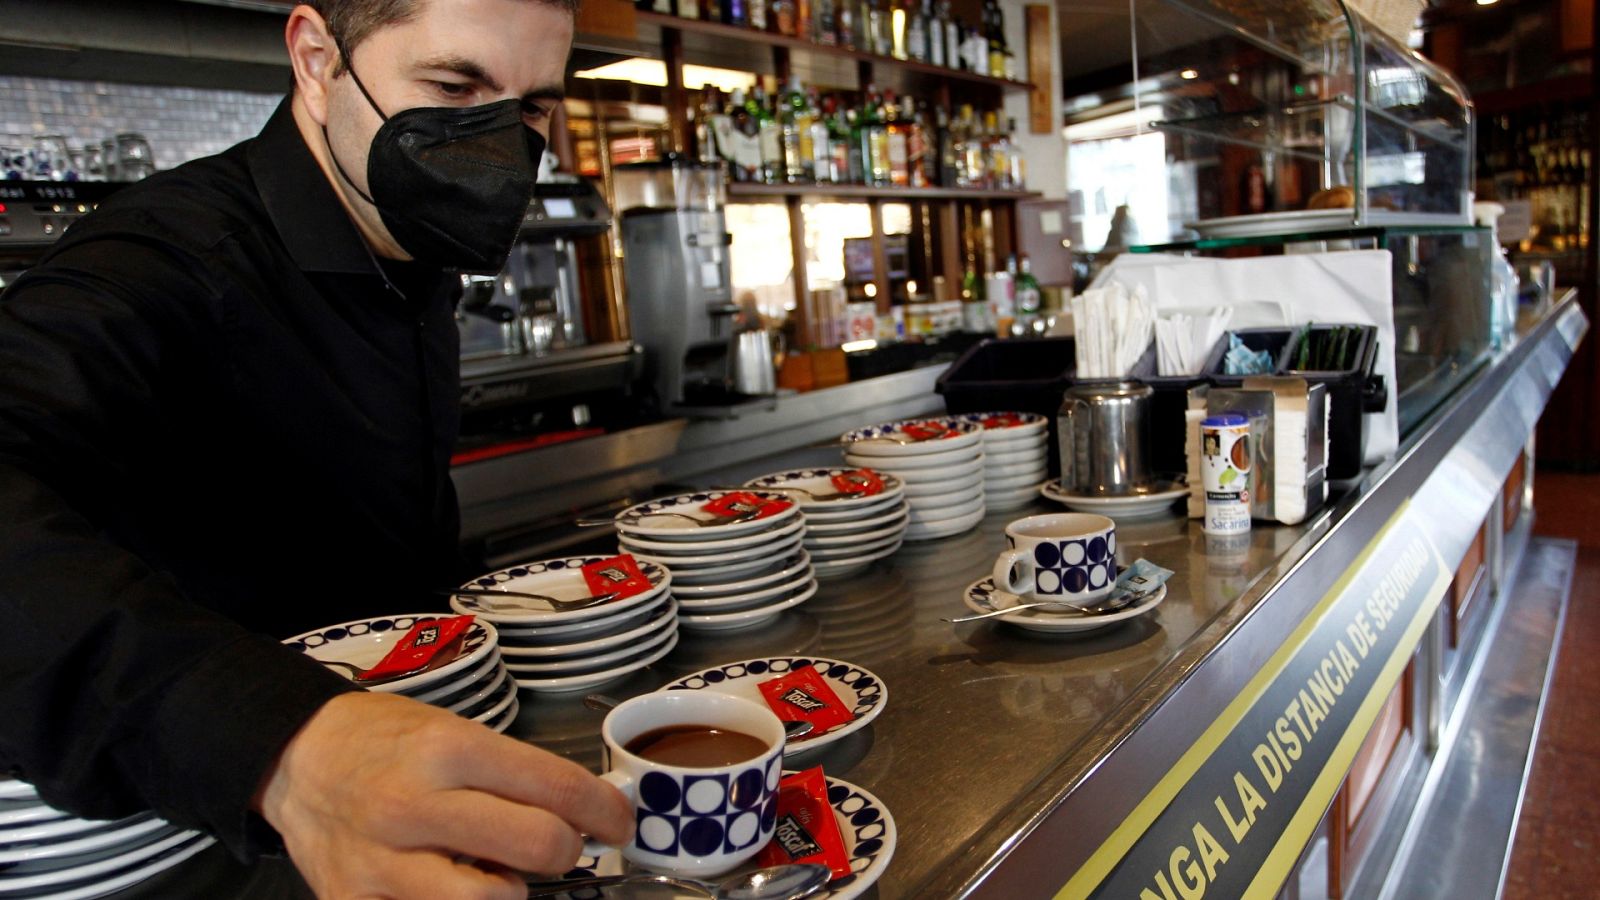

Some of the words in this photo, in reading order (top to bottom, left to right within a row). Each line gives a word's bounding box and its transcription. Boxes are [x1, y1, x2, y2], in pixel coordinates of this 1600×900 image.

[36, 187, 76, 199] 1912
[1211, 517, 1250, 530] Sacarina
[1214, 771, 1267, 845] LA
[1252, 639, 1360, 793] DISTANCIA
[1346, 610, 1379, 660] DE
[1366, 538, 1430, 630] SEGURIDAD
